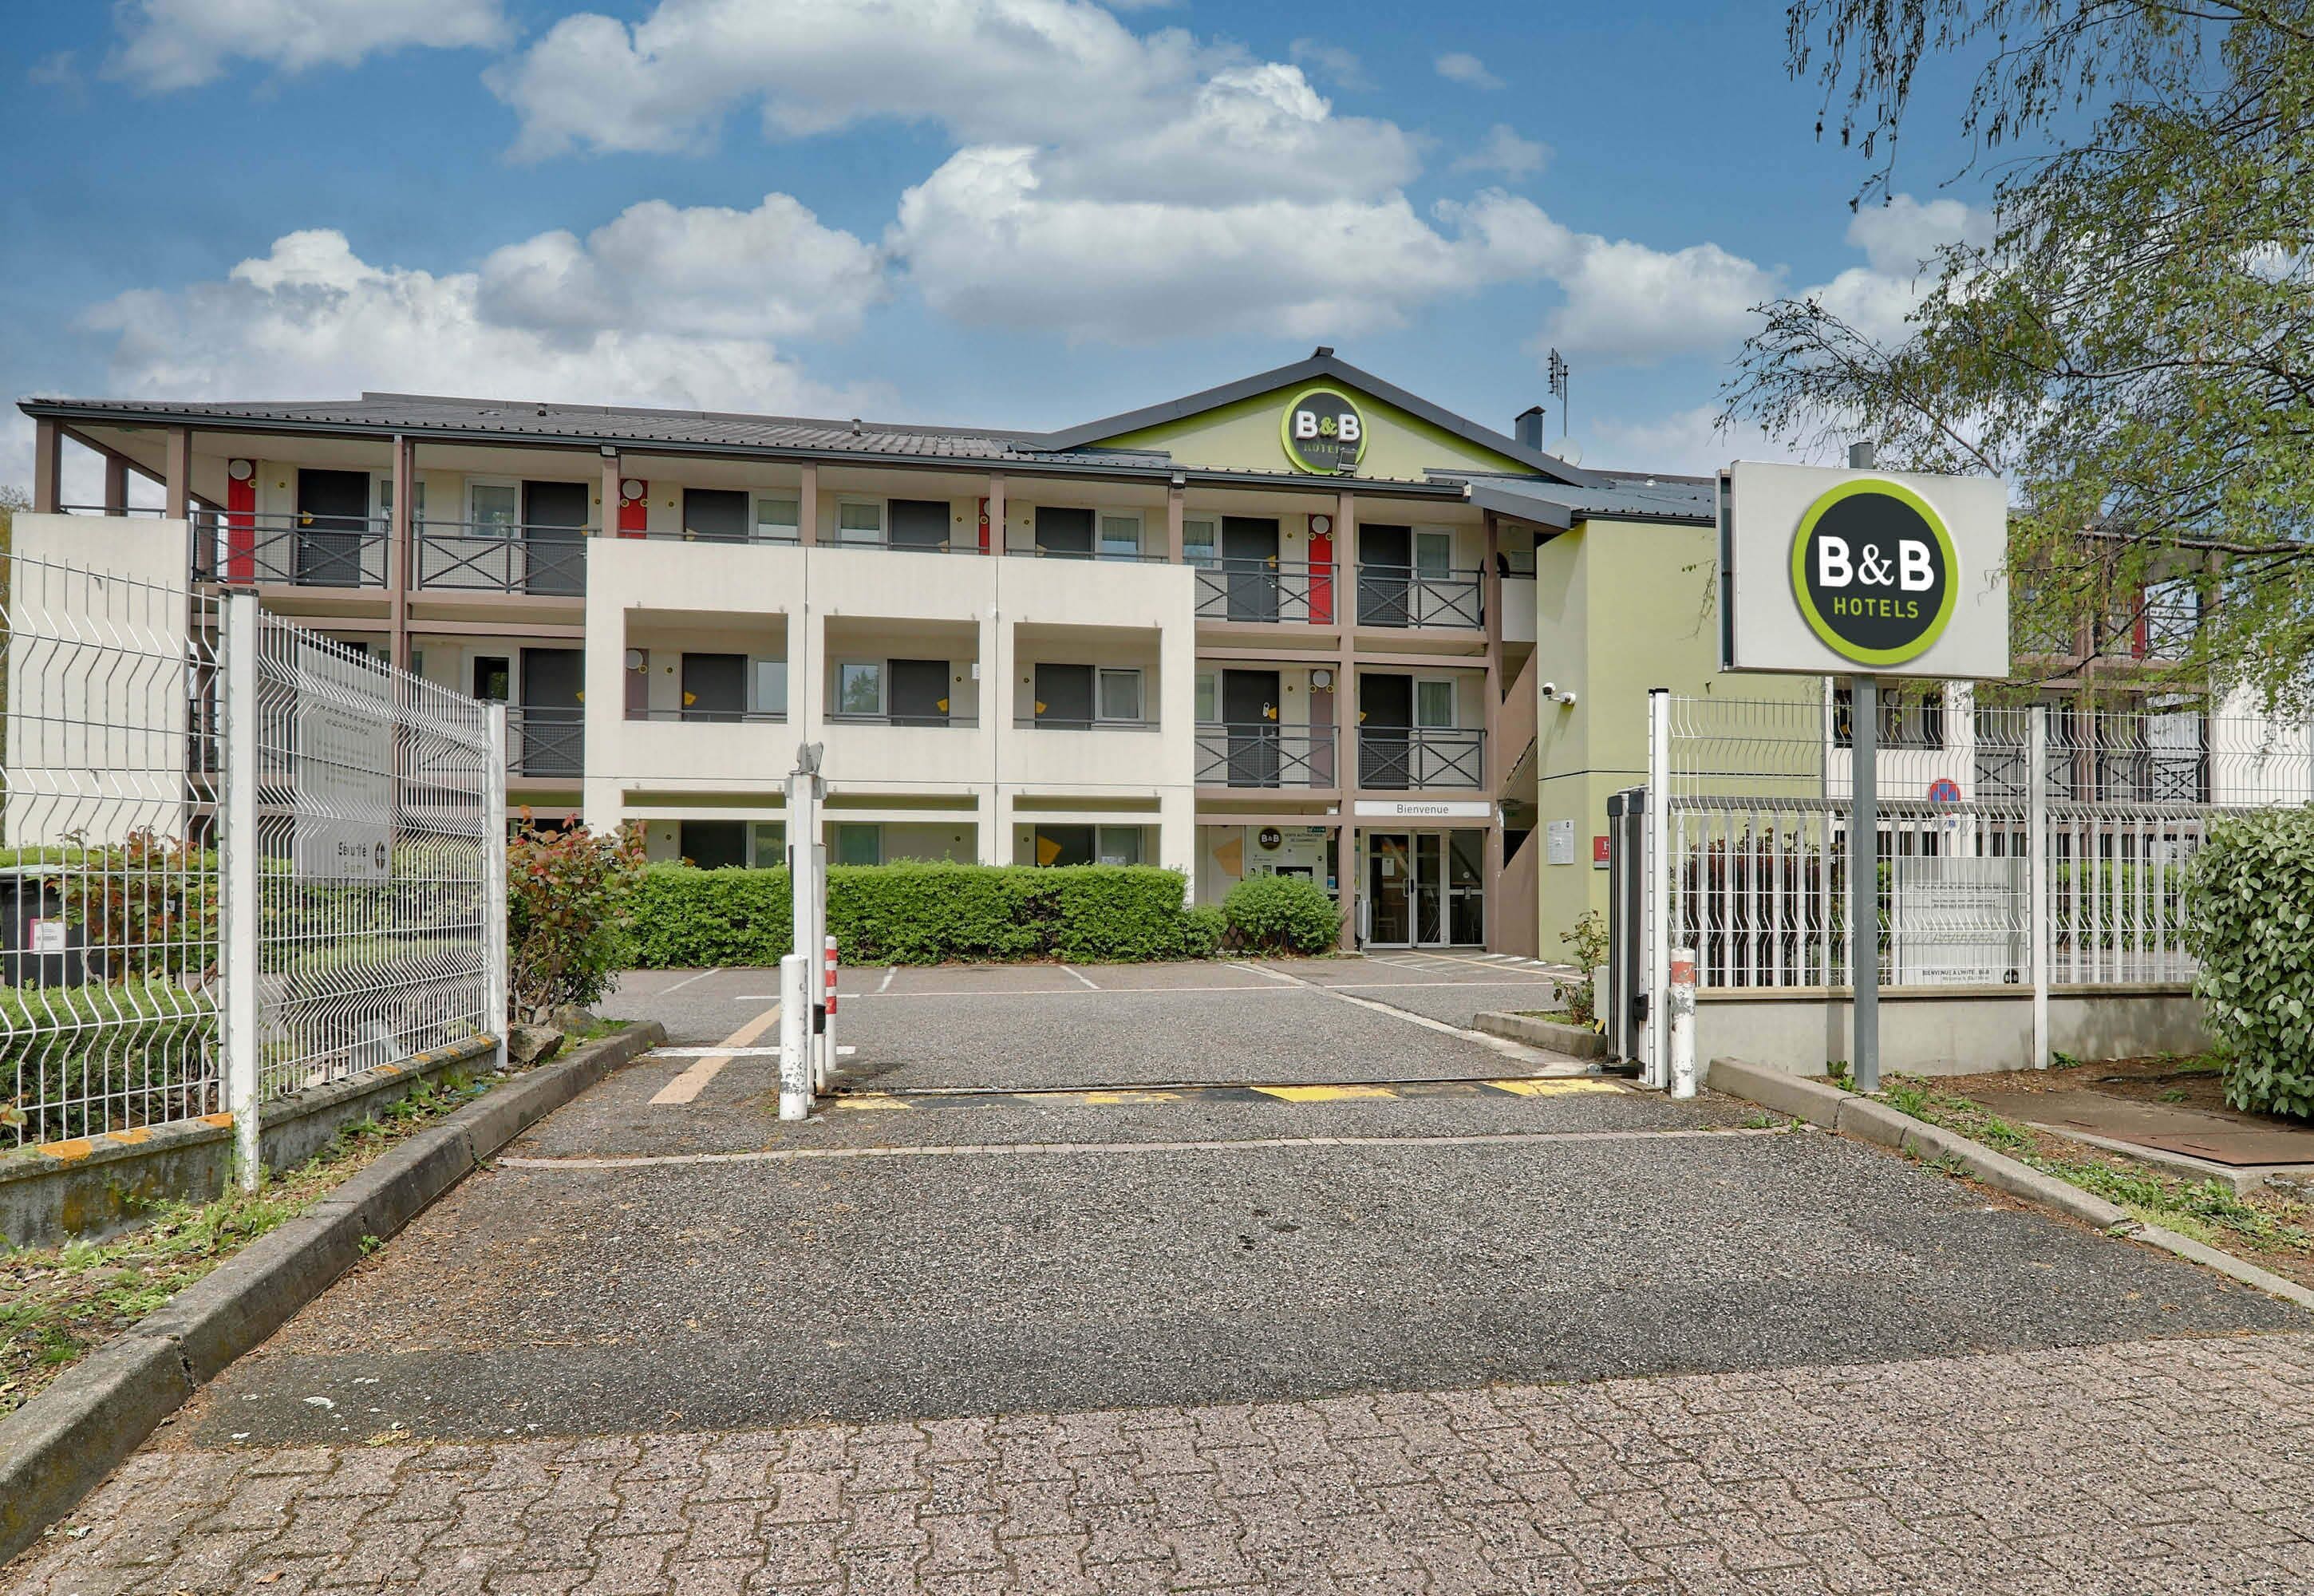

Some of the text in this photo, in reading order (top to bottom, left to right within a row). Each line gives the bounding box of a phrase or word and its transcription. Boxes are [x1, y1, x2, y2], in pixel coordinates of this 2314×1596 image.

[1296, 411, 1360, 443] B&B
[1818, 535, 1935, 591] B&B
[1834, 597, 1919, 618] HOTELS
[1396, 804, 1449, 814] Bienvenue
